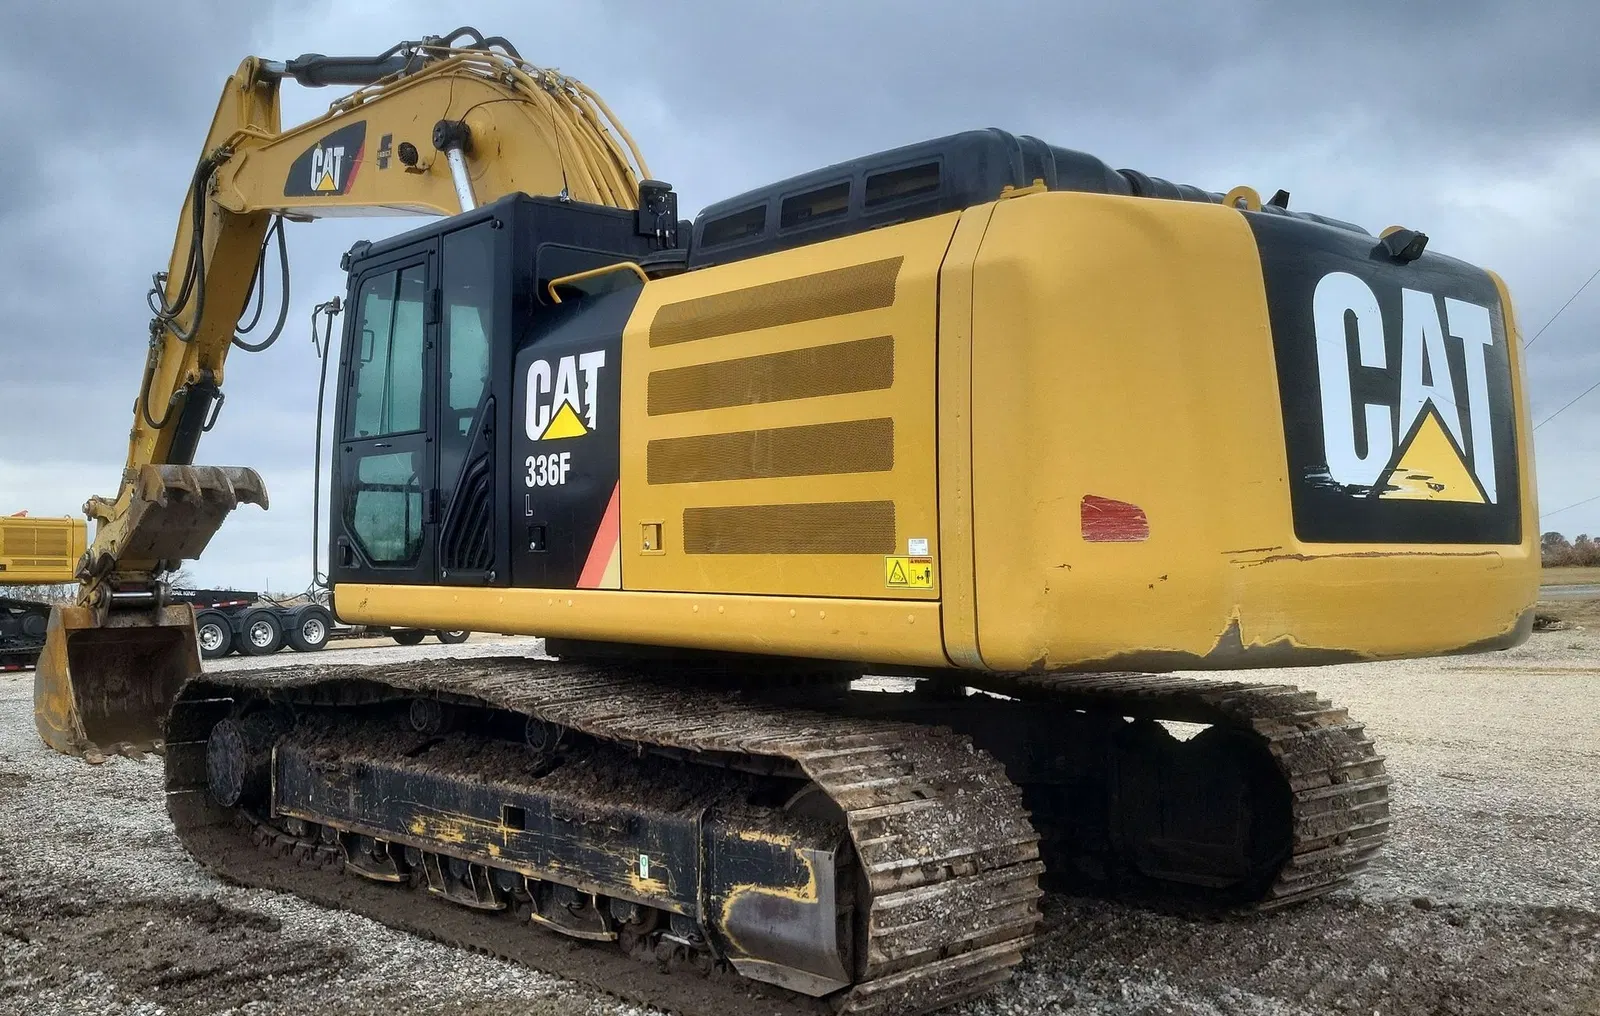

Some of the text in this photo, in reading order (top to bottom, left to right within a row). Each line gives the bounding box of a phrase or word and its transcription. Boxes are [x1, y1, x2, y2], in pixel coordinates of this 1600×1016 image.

[310, 146, 345, 191] CAT
[525, 350, 606, 442] CAT
[1312, 271, 1498, 505] CAT
[525, 452, 571, 488] 336F
[525, 493, 534, 517] L
